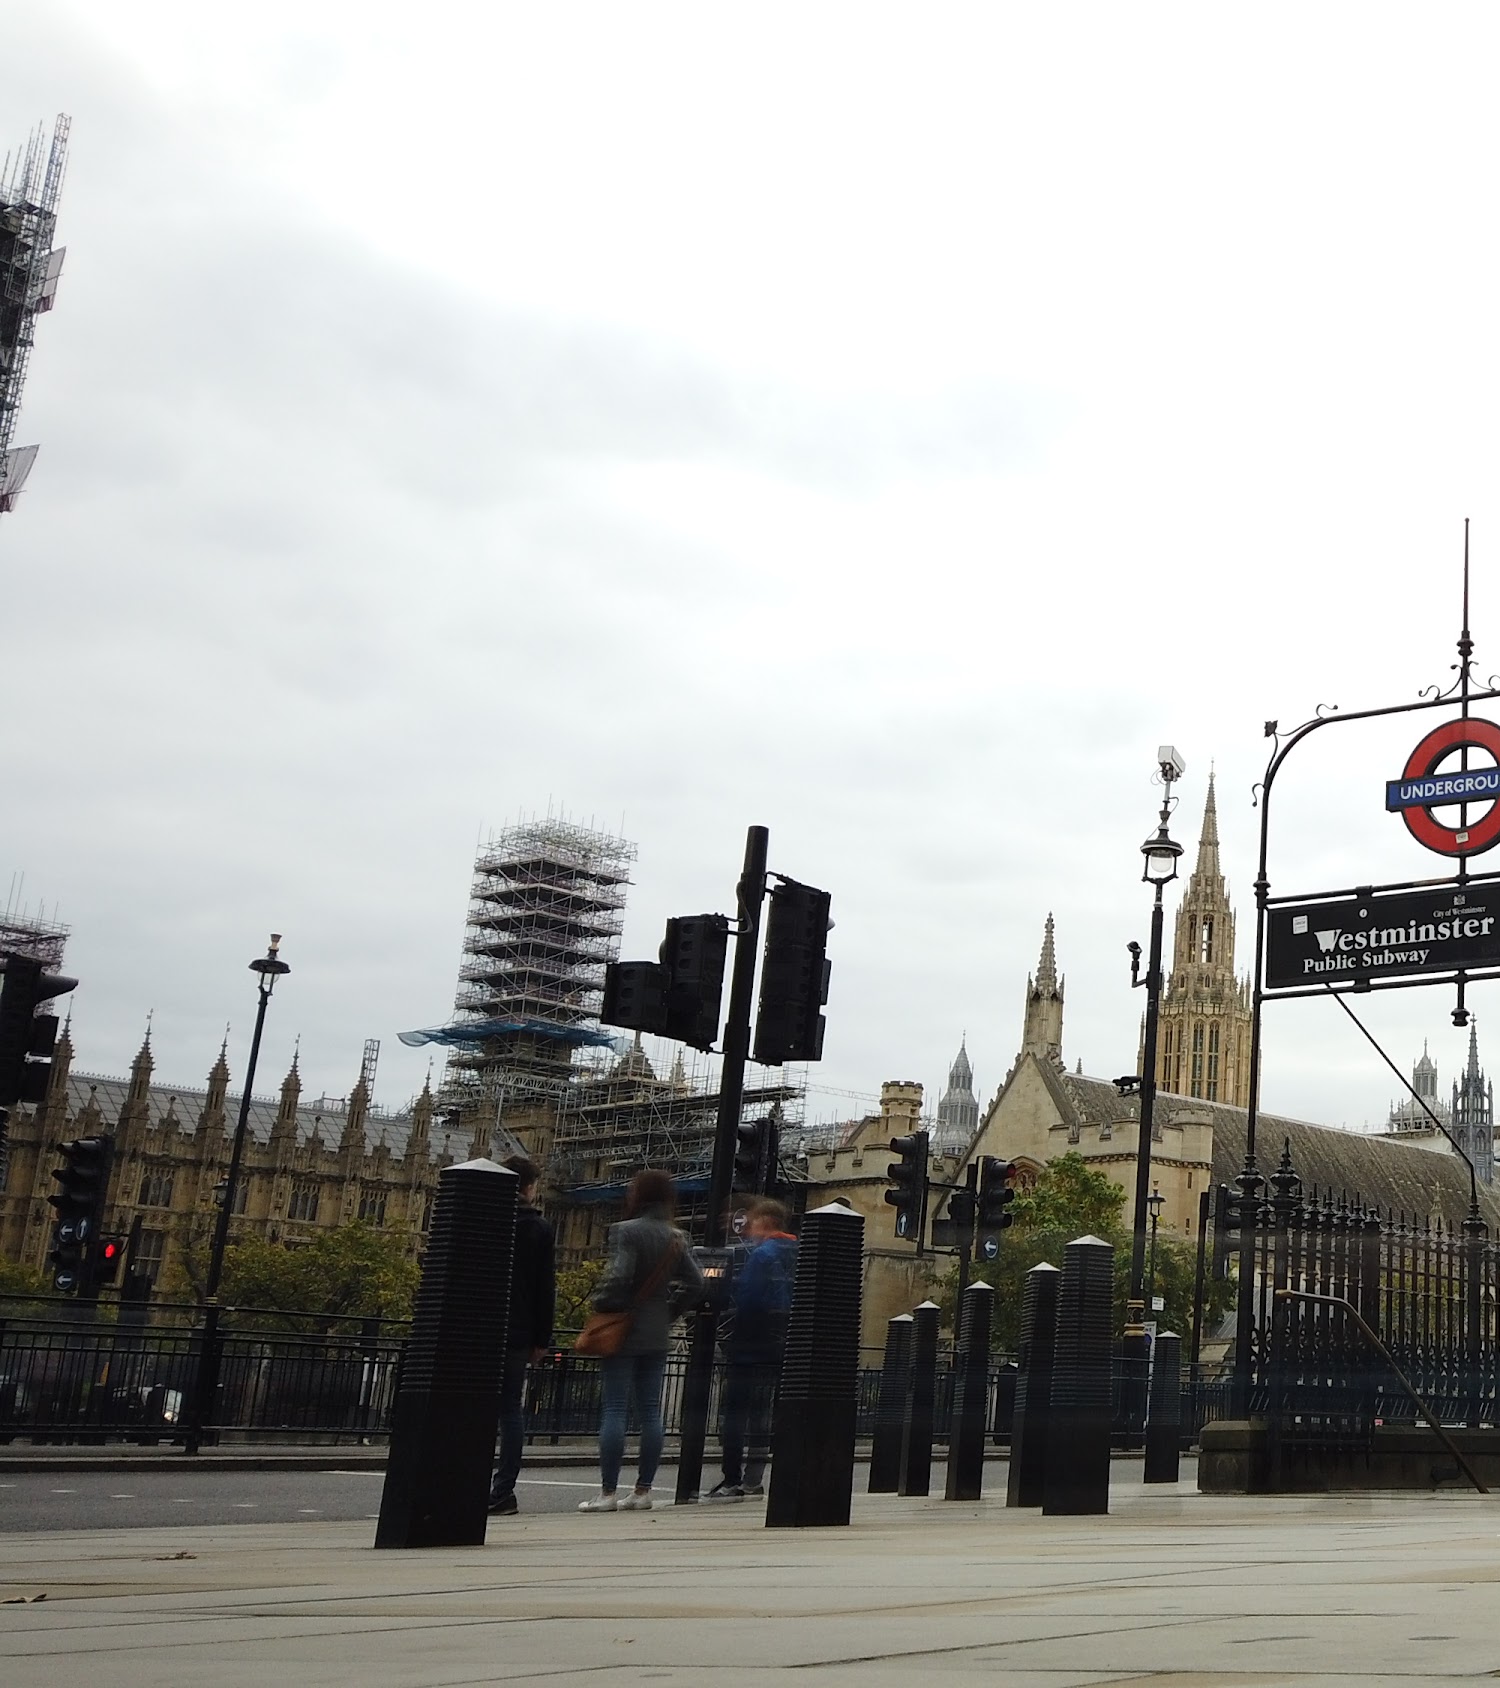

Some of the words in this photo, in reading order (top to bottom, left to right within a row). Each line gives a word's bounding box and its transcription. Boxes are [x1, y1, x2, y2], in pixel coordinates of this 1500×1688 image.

[1314, 916, 1495, 953] Westminster
[1303, 953, 1357, 974] Public
[1362, 949, 1430, 967] Subway
